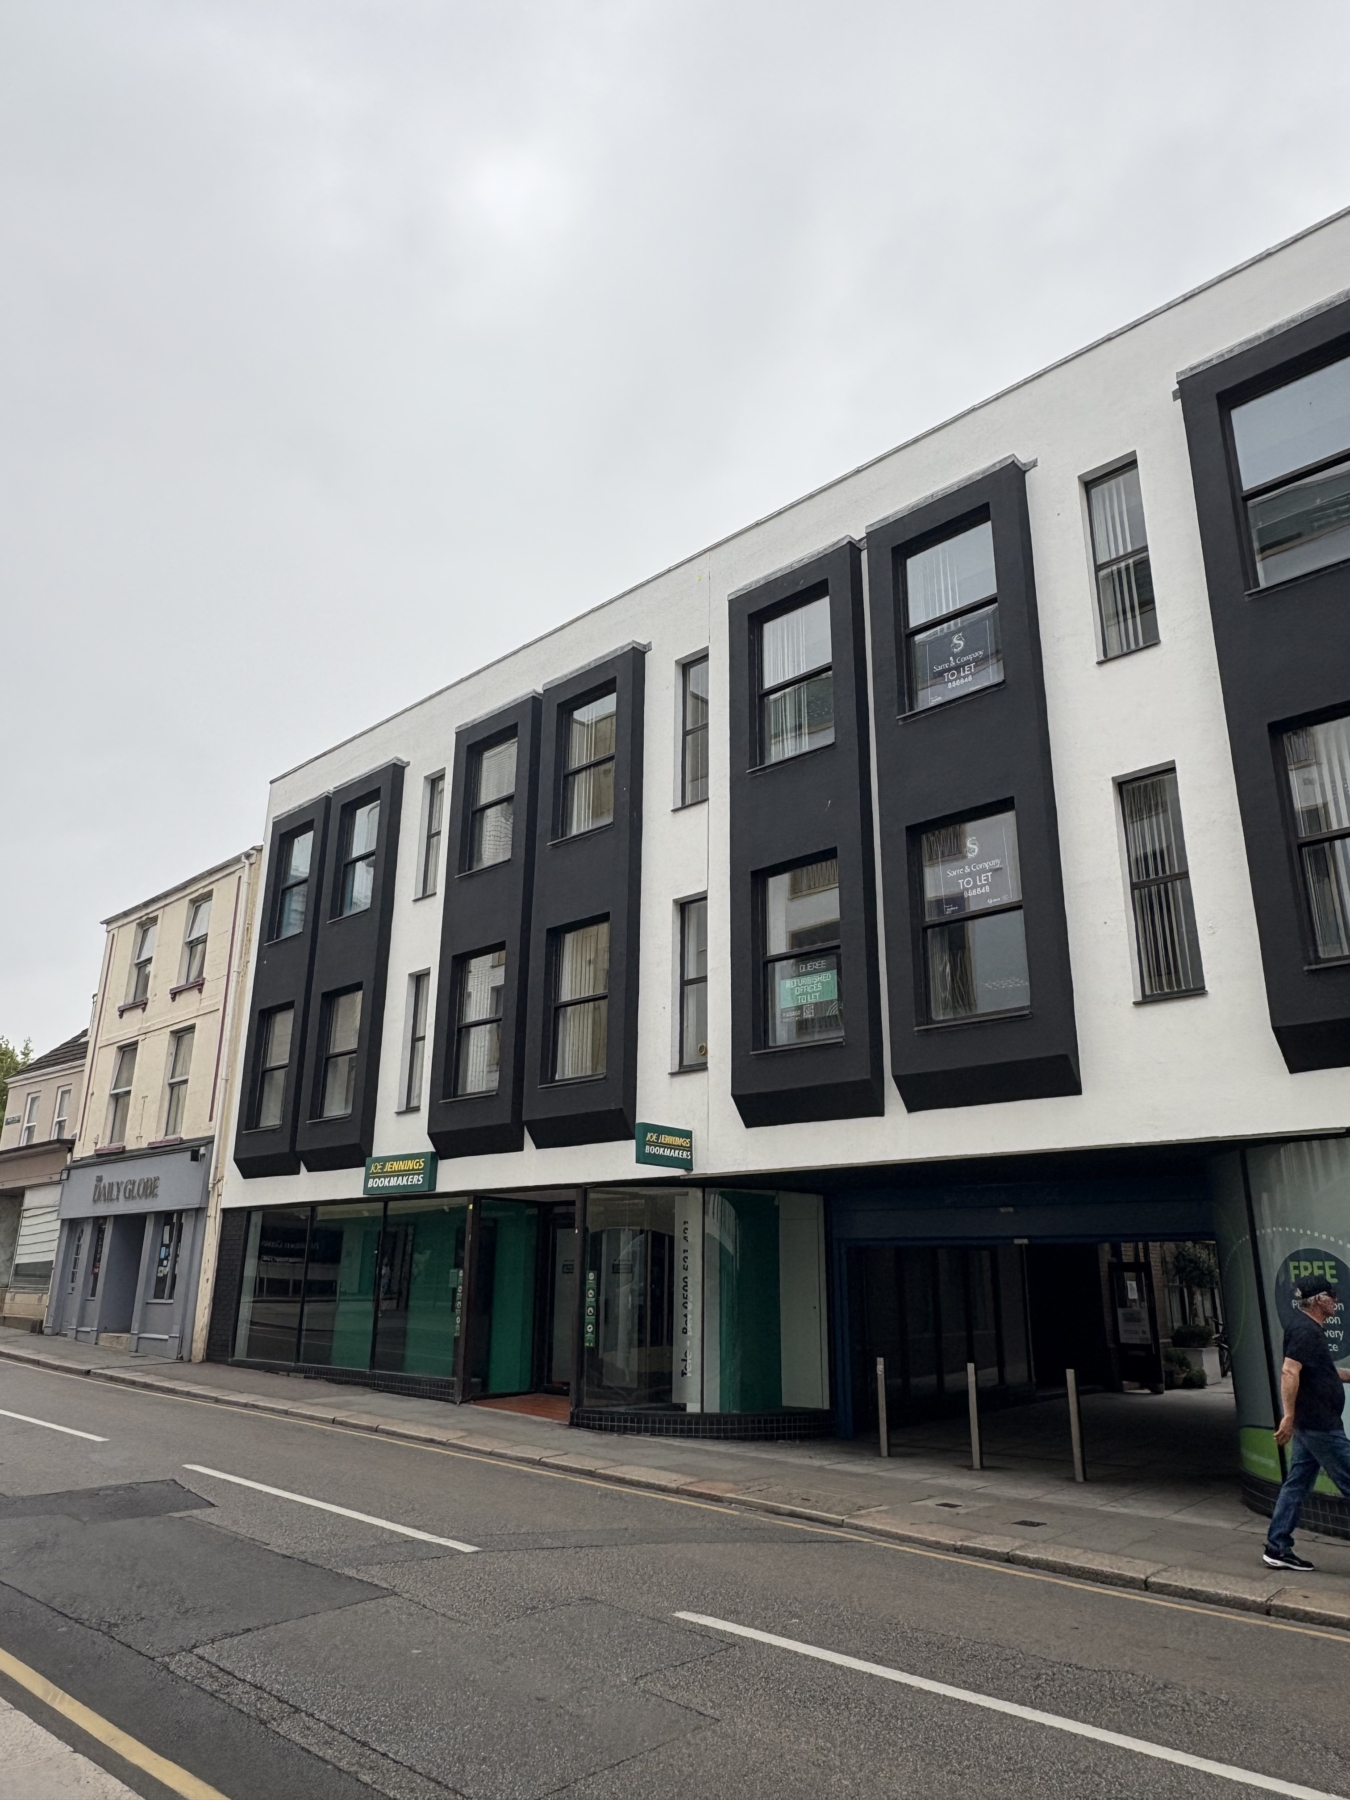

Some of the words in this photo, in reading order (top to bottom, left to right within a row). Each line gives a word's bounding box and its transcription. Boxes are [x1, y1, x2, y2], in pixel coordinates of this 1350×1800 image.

[956, 650, 984, 664] Company
[943, 670, 957, 682] TO
[960, 663, 976, 676] LET
[964, 865, 970, 873] &
[971, 858, 1001, 870] Company
[957, 877, 973, 890] TO
[976, 872, 992, 886] LET
[795, 983, 822, 995] OFFICES
[797, 995, 806, 1003] TO
[808, 992, 820, 1002] LET
[646, 1131, 658, 1142] JOE
[645, 1145, 691, 1159] BOOKMAKERS
[369, 1162, 383, 1173] JOE
[384, 1158, 425, 1172] JENNINGS
[368, 1174, 424, 1188] BOOKMAKERS
[93, 1180, 124, 1203] DAILY
[124, 1176, 160, 1200] GLOBE
[1289, 1261, 1338, 1283] FREE
